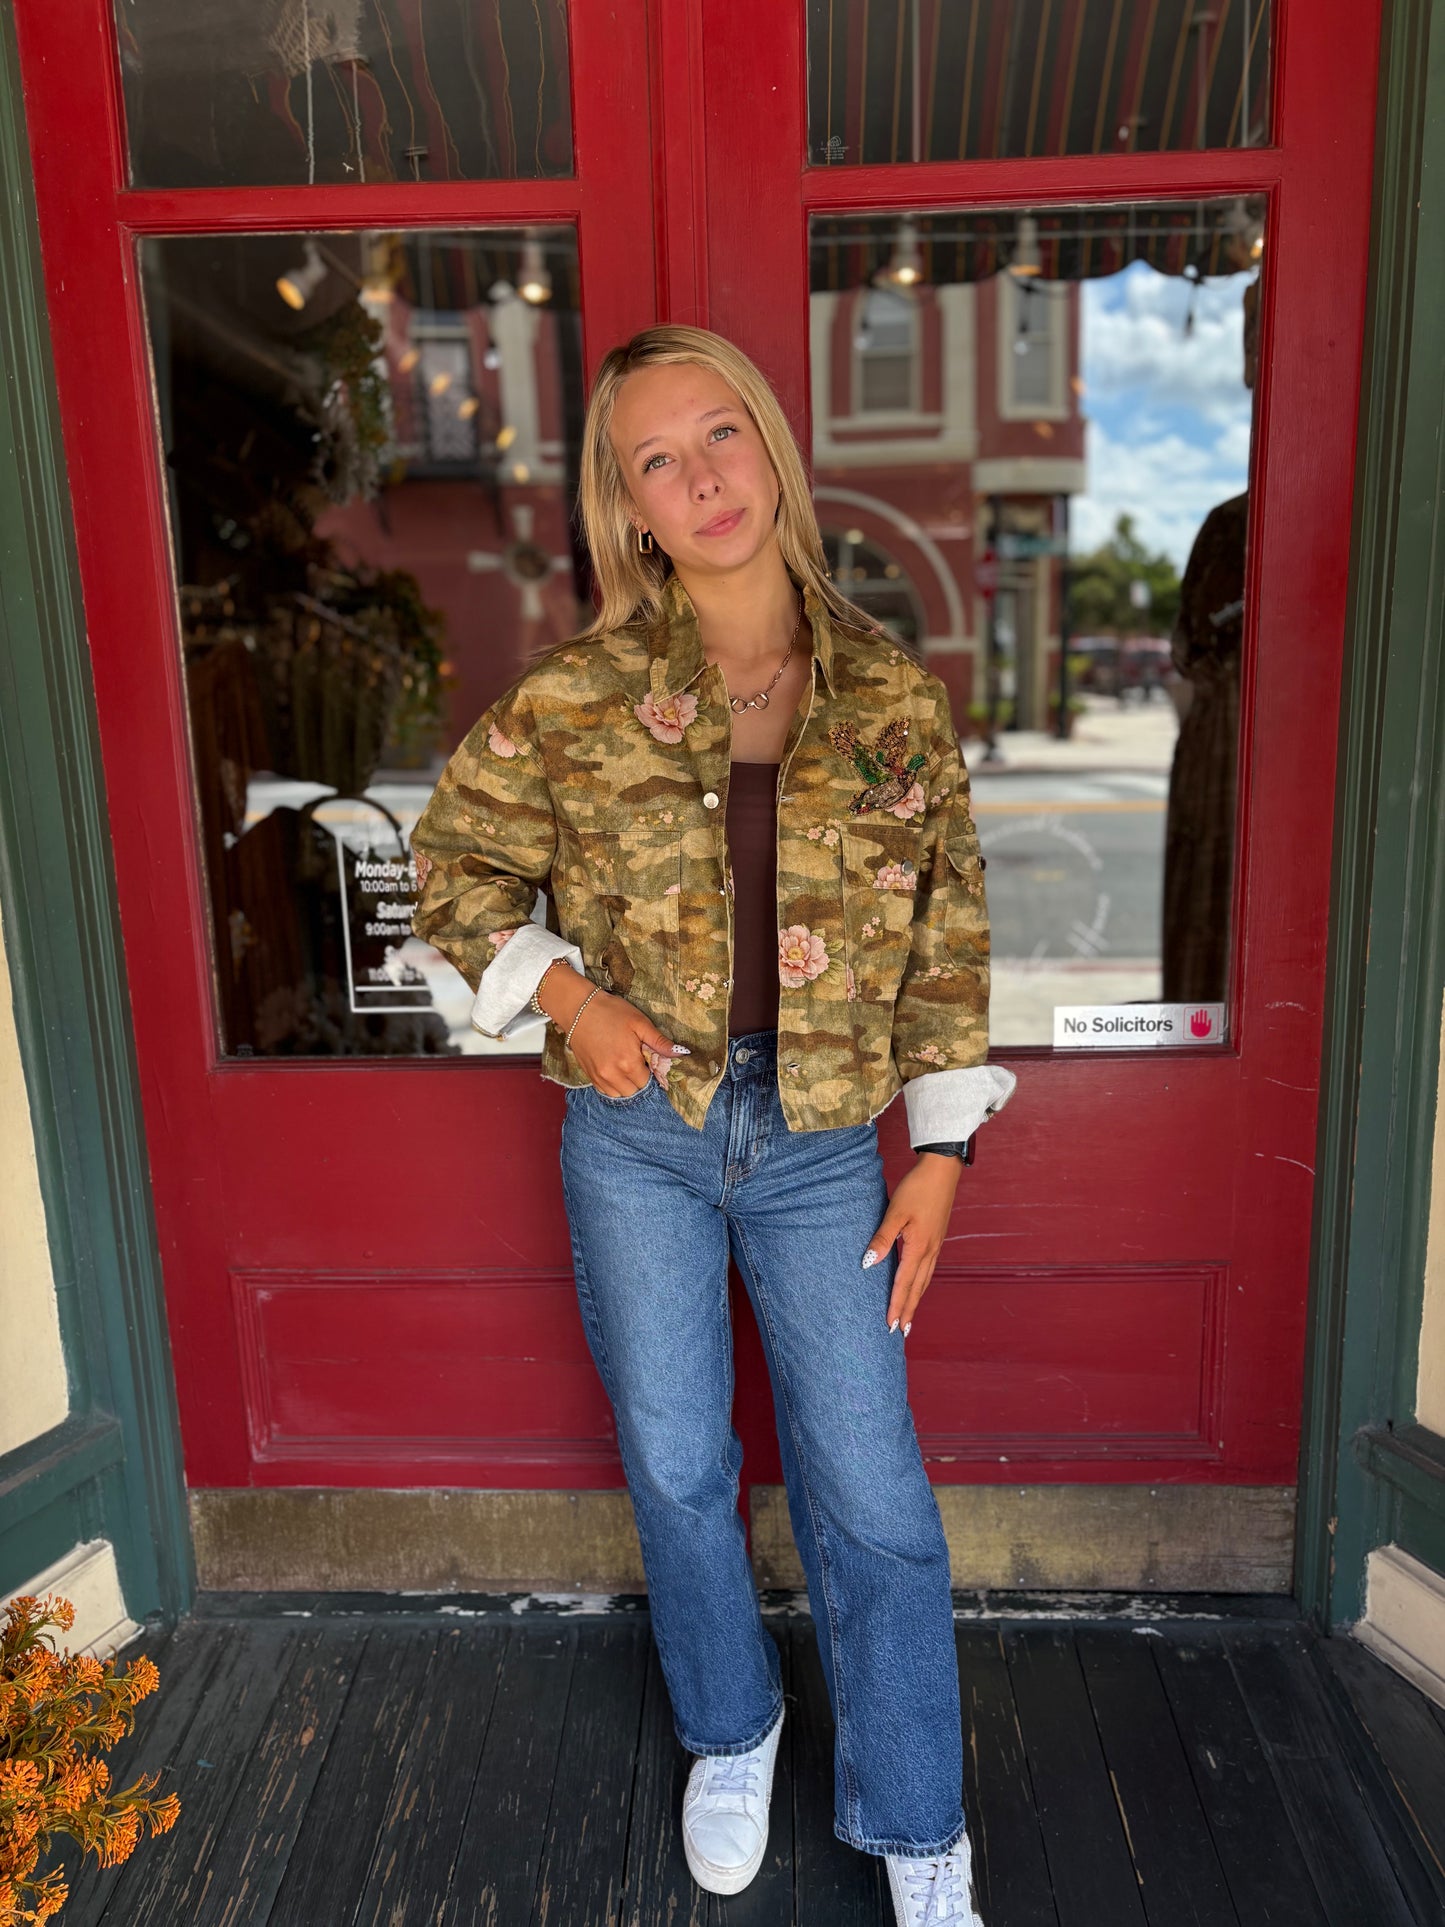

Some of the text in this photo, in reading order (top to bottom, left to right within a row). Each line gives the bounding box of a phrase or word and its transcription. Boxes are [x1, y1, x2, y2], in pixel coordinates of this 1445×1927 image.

[360, 881, 398, 893] 10:00am
[400, 881, 410, 892] to
[1064, 1016, 1173, 1033] No Solicitors
